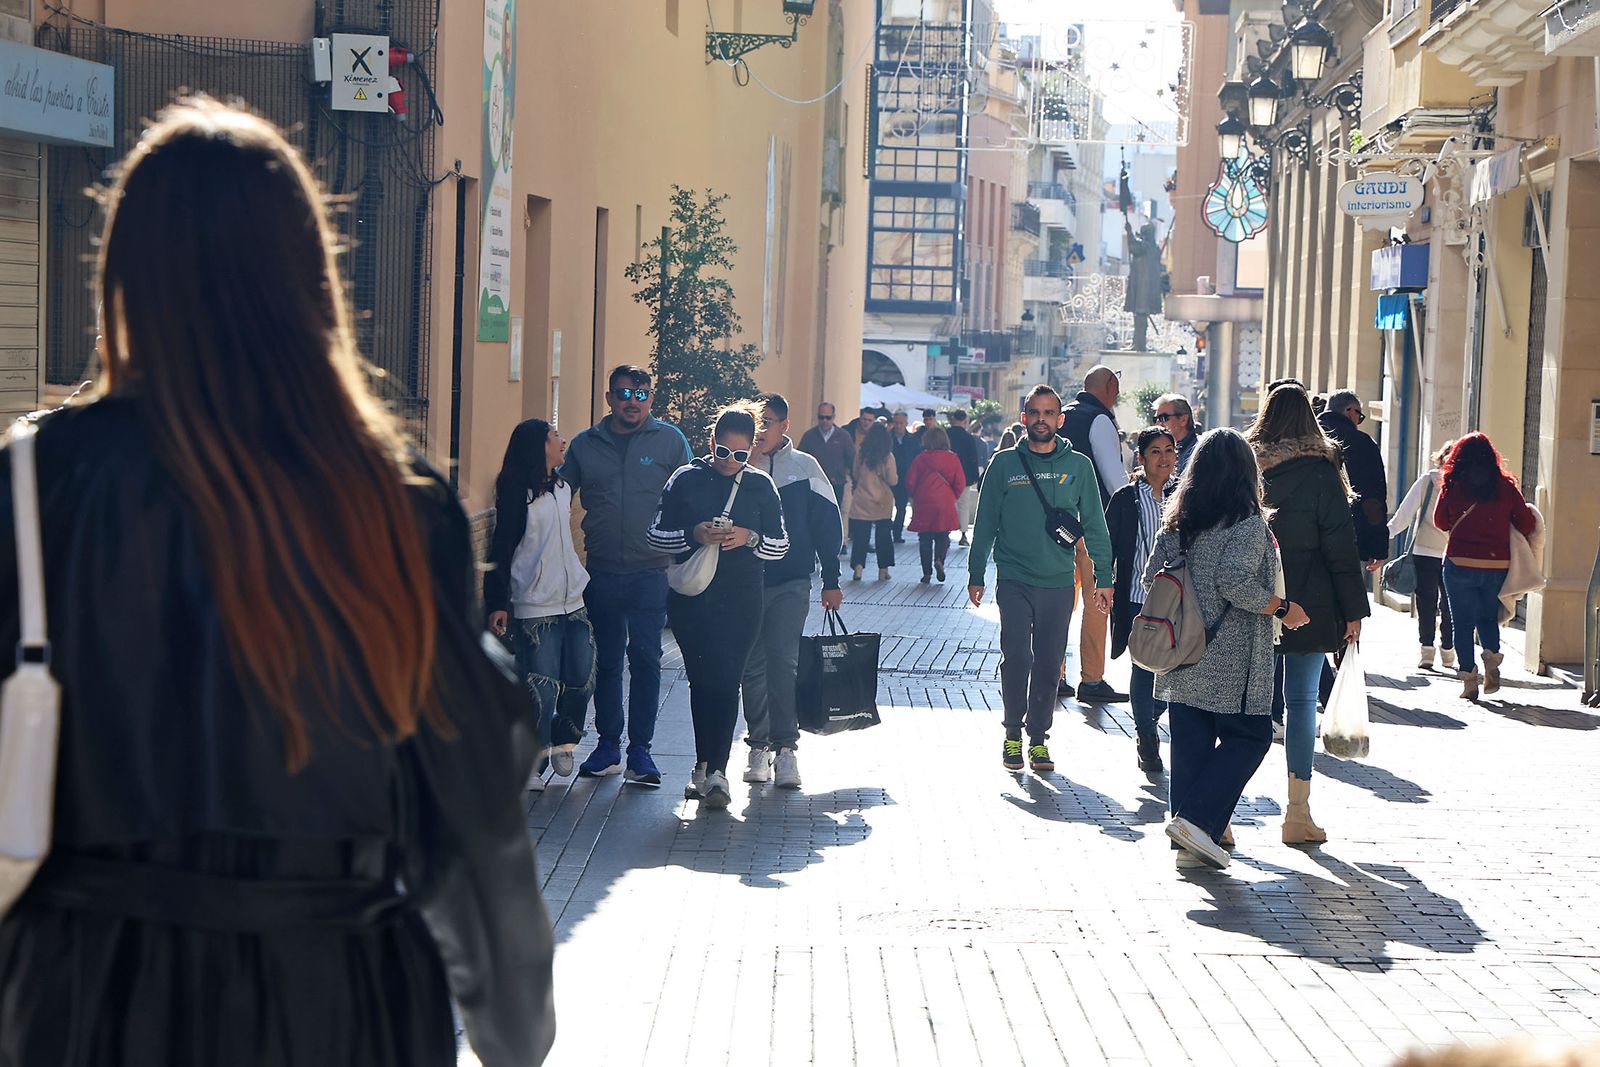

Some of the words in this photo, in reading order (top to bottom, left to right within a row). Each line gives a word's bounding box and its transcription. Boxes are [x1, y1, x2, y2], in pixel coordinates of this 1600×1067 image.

[43, 80, 74, 114] puertas
[77, 95, 83, 112] a
[1354, 182, 1407, 195] GAUDI
[1347, 201, 1411, 210] interiorismo
